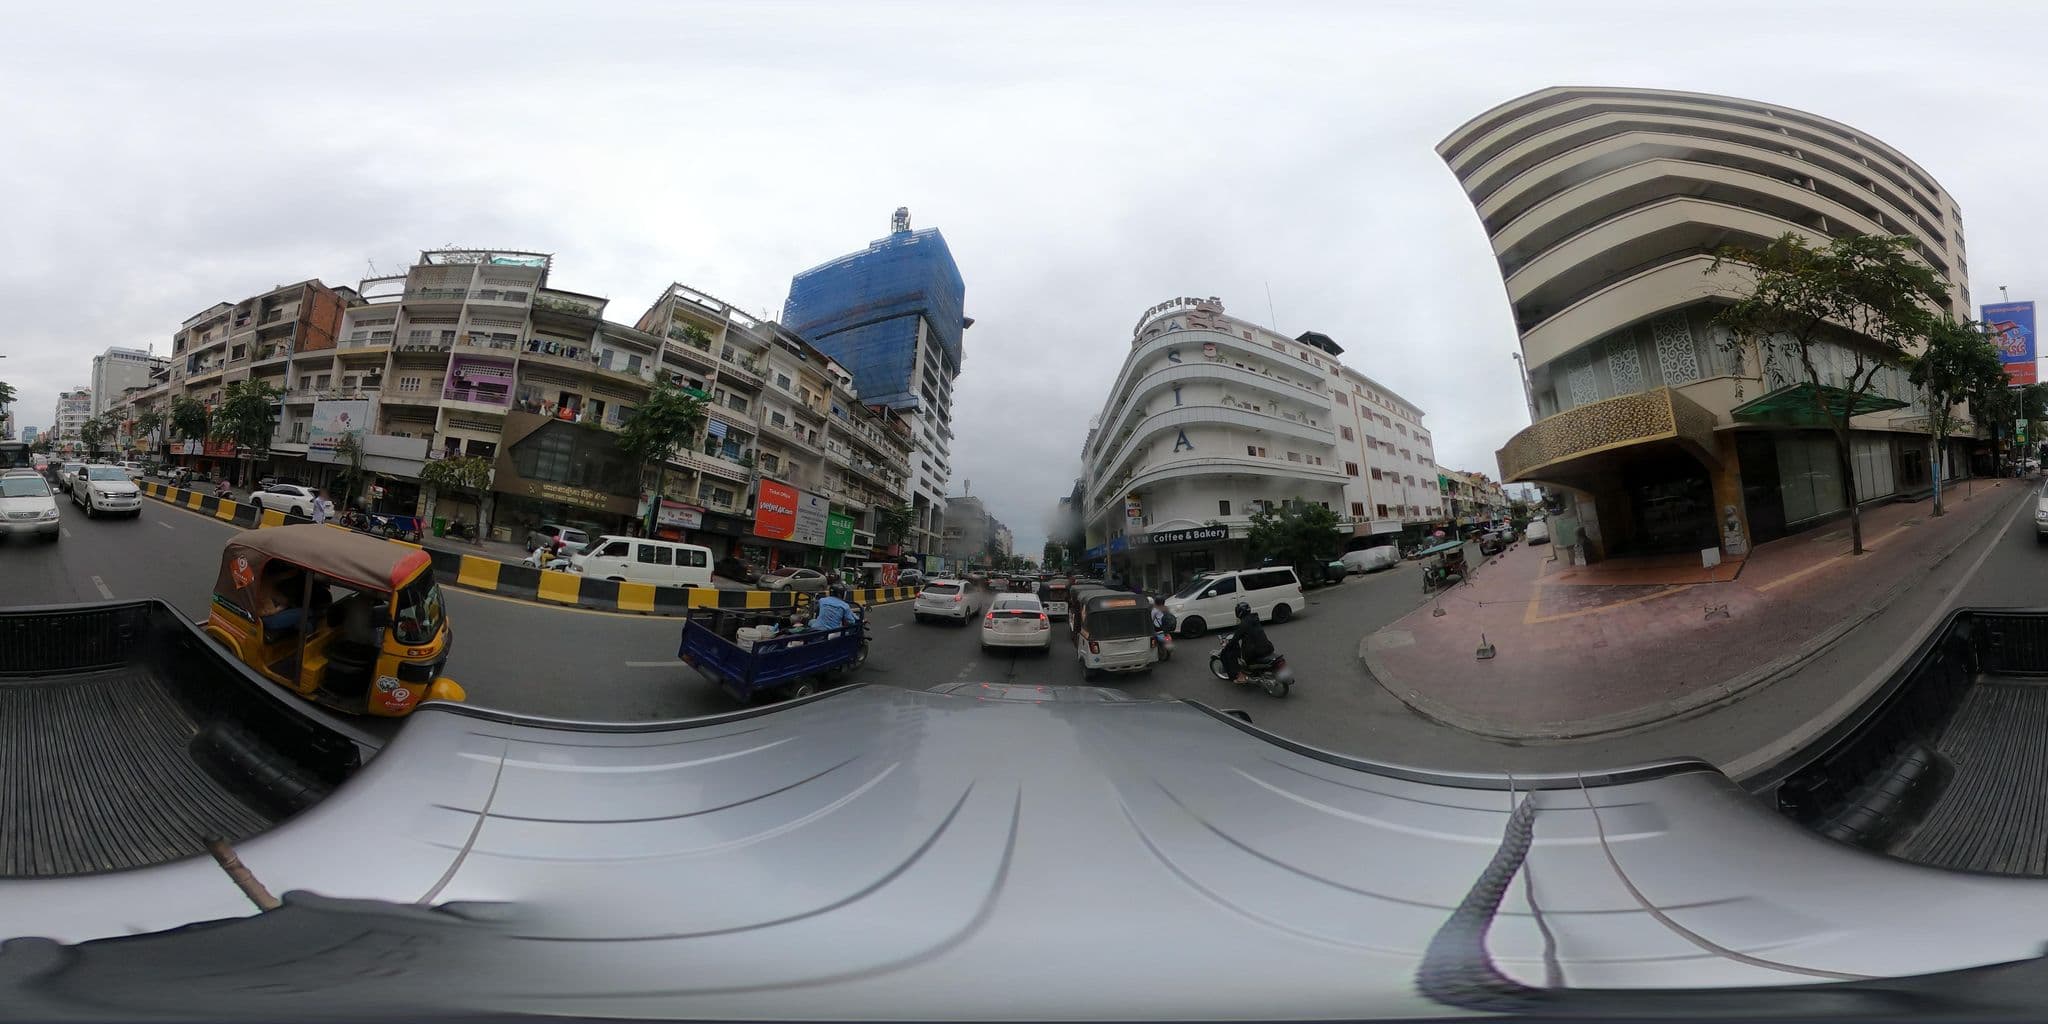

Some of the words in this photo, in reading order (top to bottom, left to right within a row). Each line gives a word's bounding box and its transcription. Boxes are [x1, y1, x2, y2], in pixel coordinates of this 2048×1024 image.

[1167, 319, 1194, 453] ASIA
[1153, 533, 1184, 543] Coffee
[1185, 531, 1192, 540] &
[1193, 528, 1226, 539] Bakery
